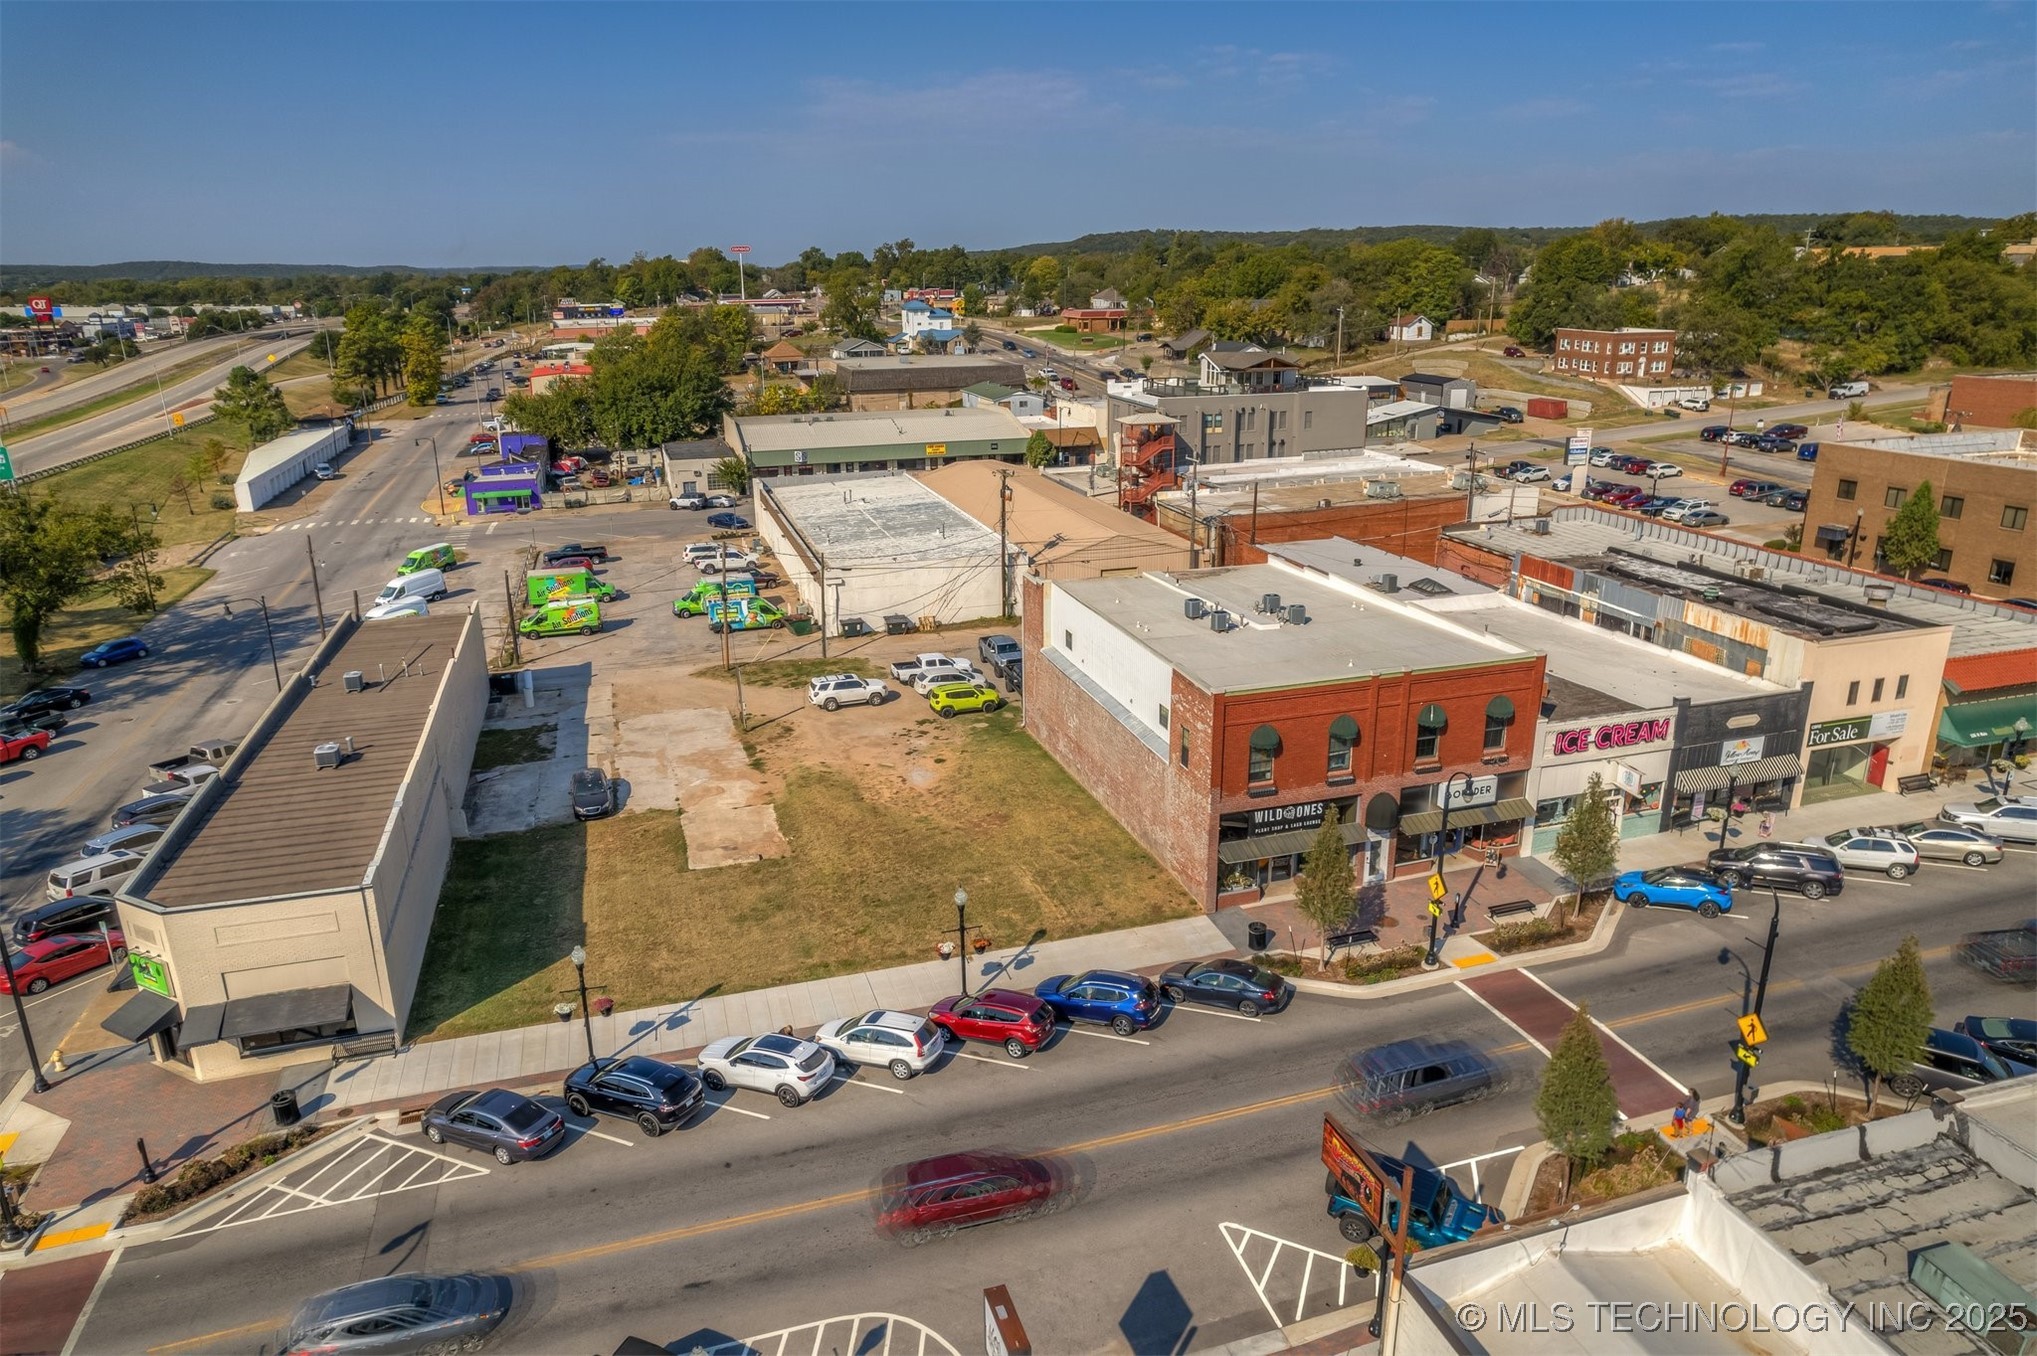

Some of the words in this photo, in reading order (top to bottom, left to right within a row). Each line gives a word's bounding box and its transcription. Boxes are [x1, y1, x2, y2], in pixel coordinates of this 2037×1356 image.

[31, 299, 47, 310] QT
[536, 589, 546, 598] Air
[546, 577, 575, 593] Solutions
[551, 621, 562, 630] Air
[561, 607, 594, 625] Solutions
[1554, 727, 1592, 756] ICE
[1594, 718, 1671, 750] CREAM
[1808, 730, 1831, 746] For
[1831, 724, 1858, 742] Sale
[1254, 807, 1283, 824] WILD
[1296, 802, 1324, 818] ONES
